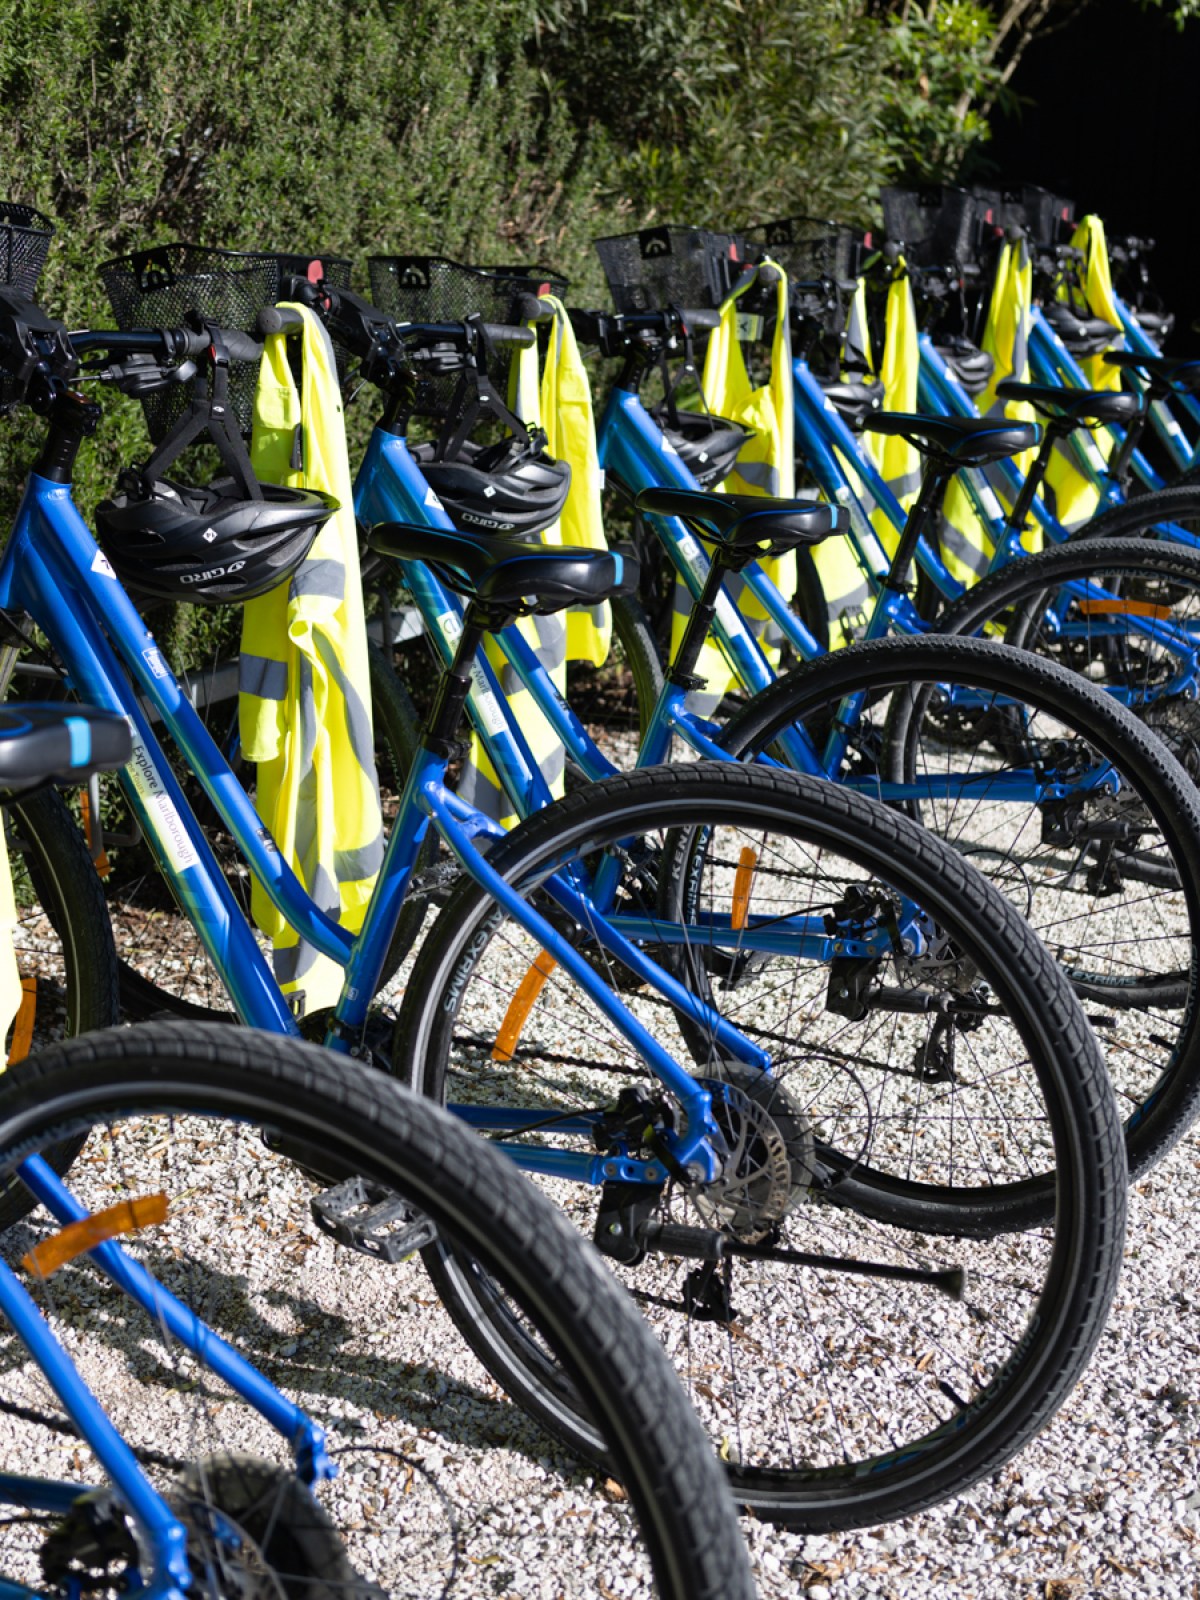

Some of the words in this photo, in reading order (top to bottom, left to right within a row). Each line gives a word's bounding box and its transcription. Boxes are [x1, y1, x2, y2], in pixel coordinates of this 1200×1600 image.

[461, 512, 499, 529] GIRO
[180, 567, 225, 584] GIRO
[132, 744, 158, 789] Explore
[152, 789, 194, 864] Marlborough
[443, 907, 504, 1013] ALEXRIMS
